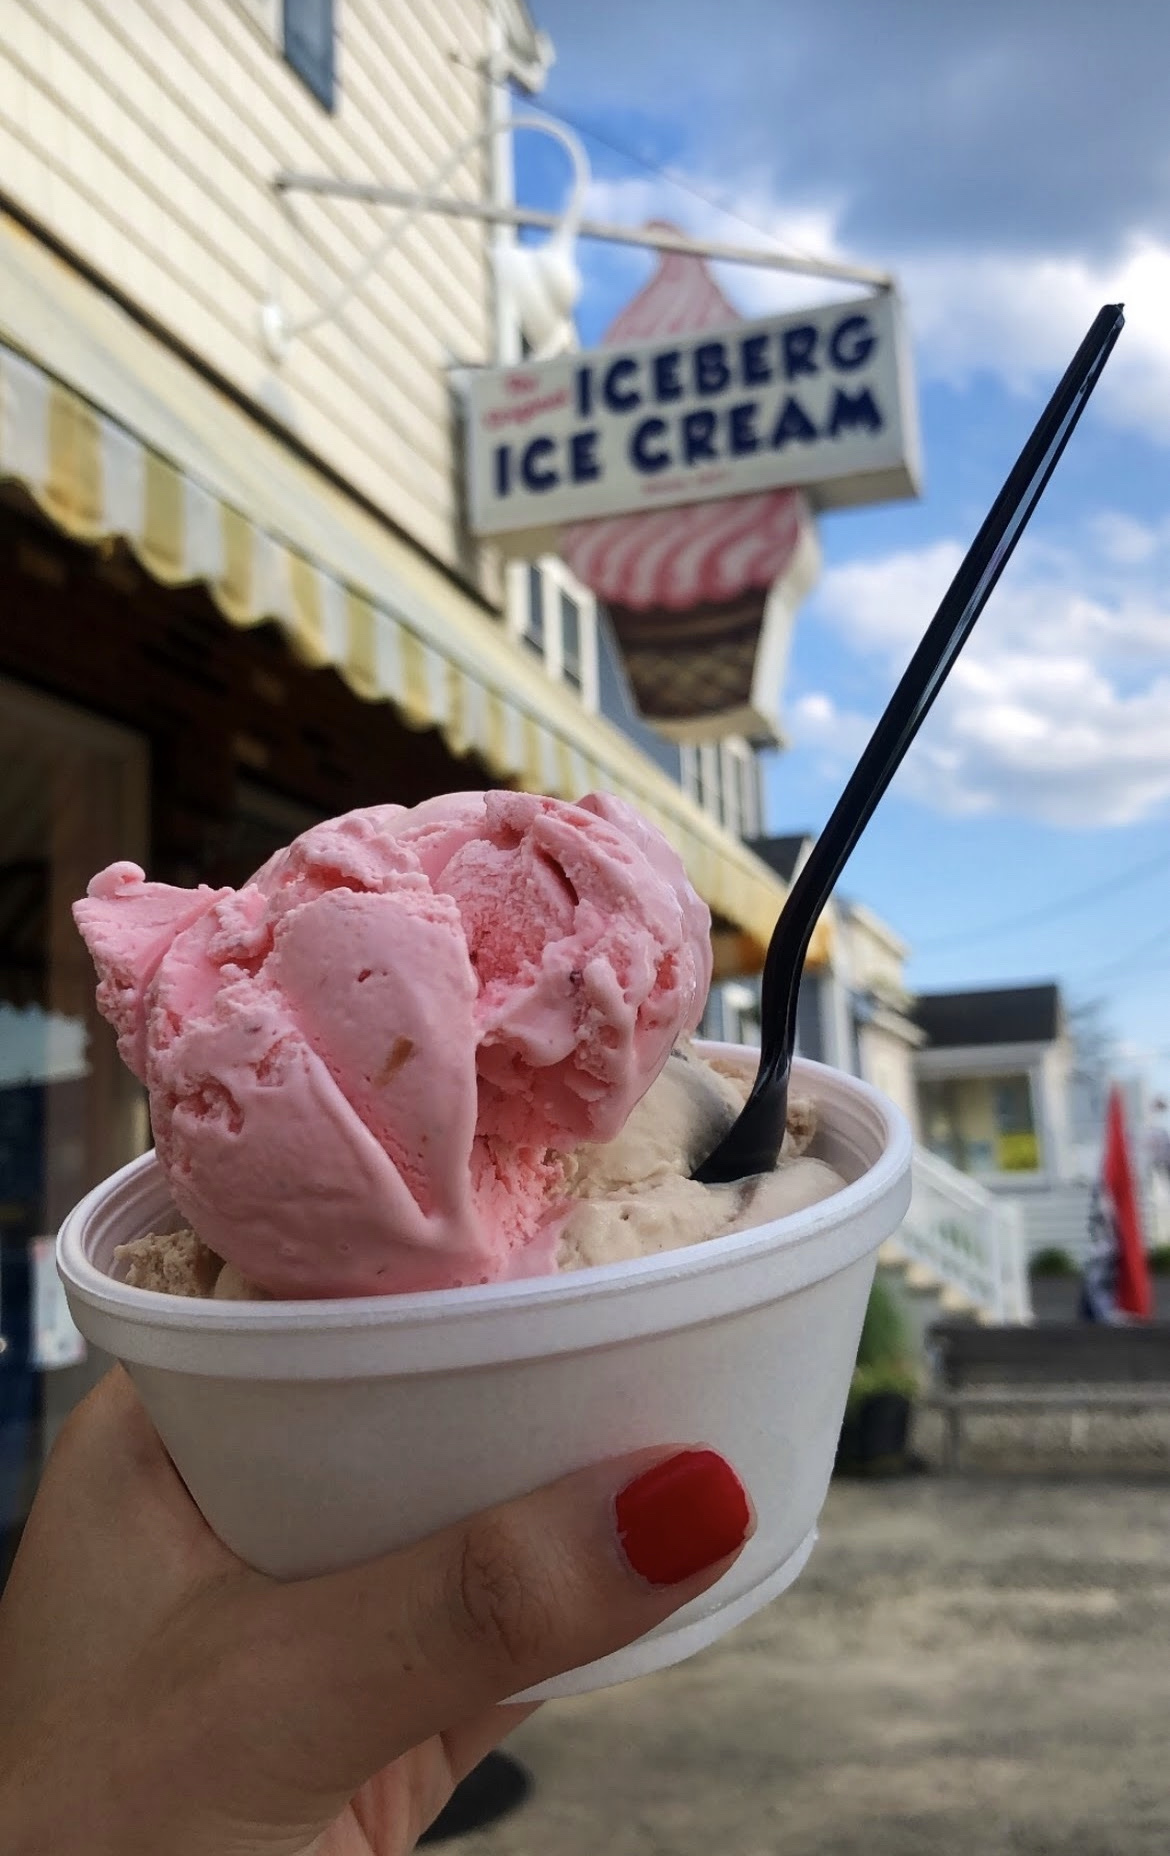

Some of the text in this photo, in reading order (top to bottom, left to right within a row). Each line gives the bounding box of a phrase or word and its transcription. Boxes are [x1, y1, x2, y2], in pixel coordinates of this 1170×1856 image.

[576, 314, 878, 418] ICEBERG
[495, 430, 603, 498] ICE
[630, 387, 884, 474] CREAM
